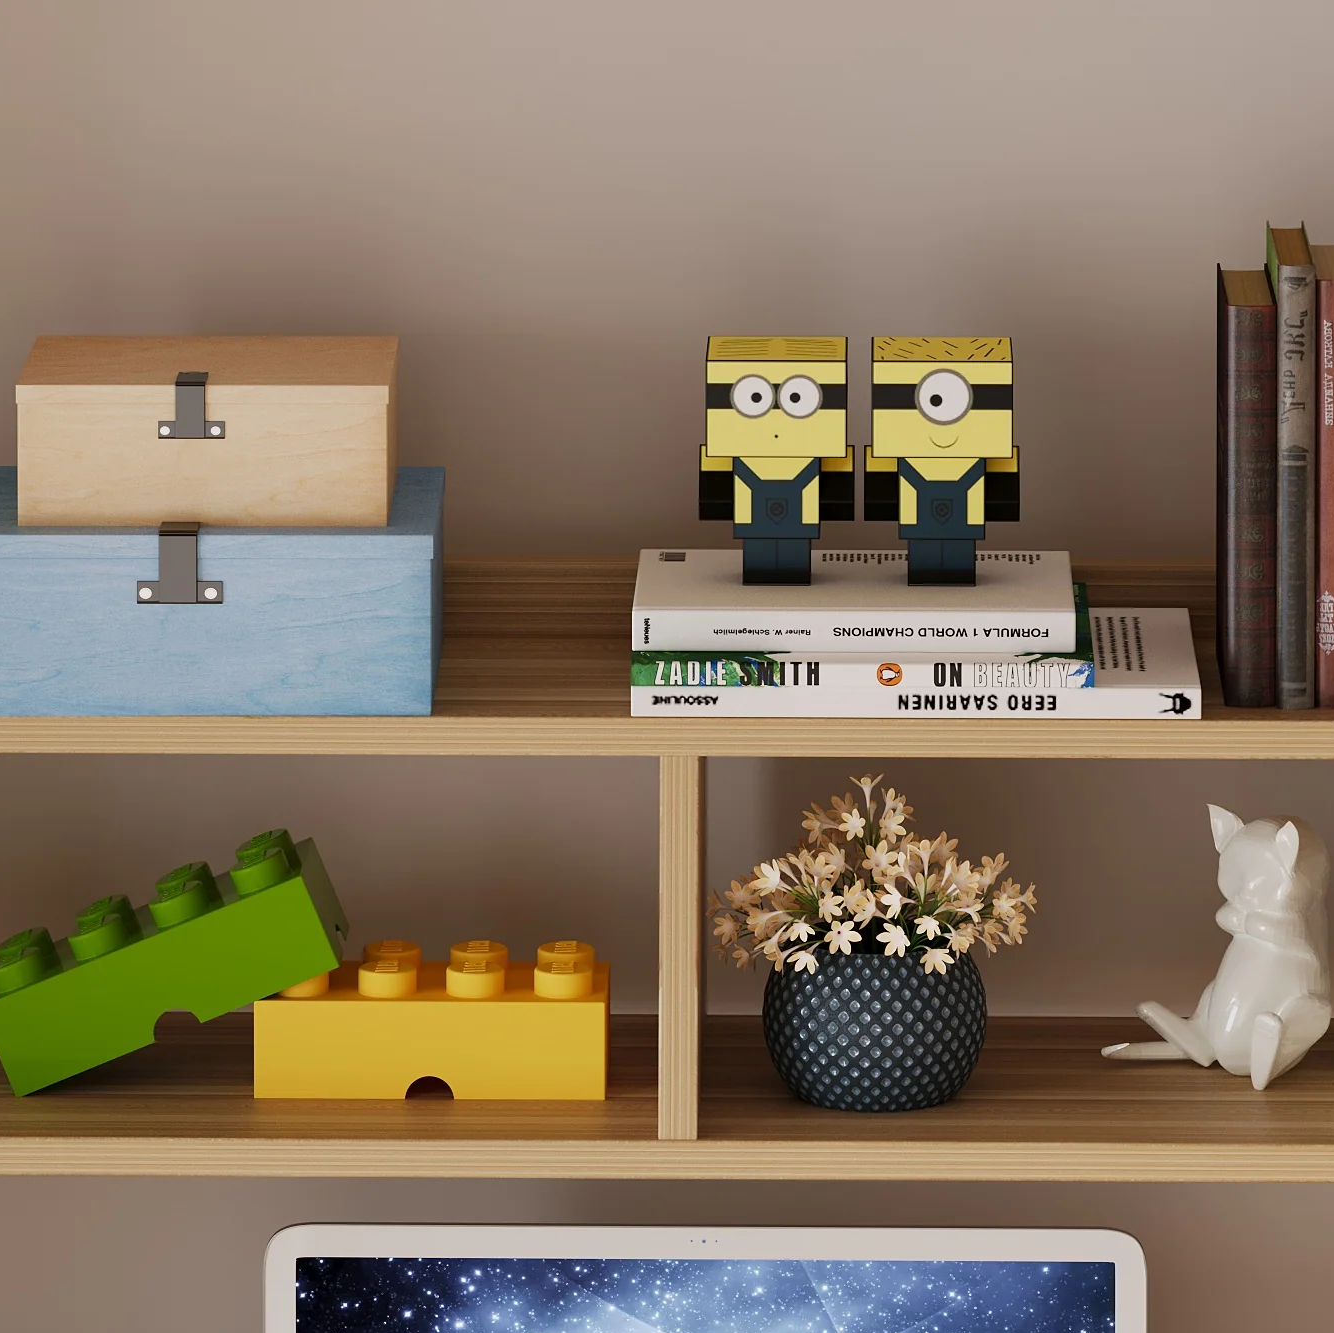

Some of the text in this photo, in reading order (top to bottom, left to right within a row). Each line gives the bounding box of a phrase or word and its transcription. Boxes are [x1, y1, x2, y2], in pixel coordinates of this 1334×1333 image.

[713, 628, 769, 637] Schlegelmilch
[833, 627, 914, 638] CHAMPIONS
[917, 627, 968, 638] WORLD
[983, 627, 1049, 638] FORMULA
[654, 661, 820, 686] ZADIE SMITH
[933, 662, 1073, 687] ON BEAUTY
[652, 695, 719, 706] ASSOULINE
[897, 694, 1057, 710] EERO SAARINEN
